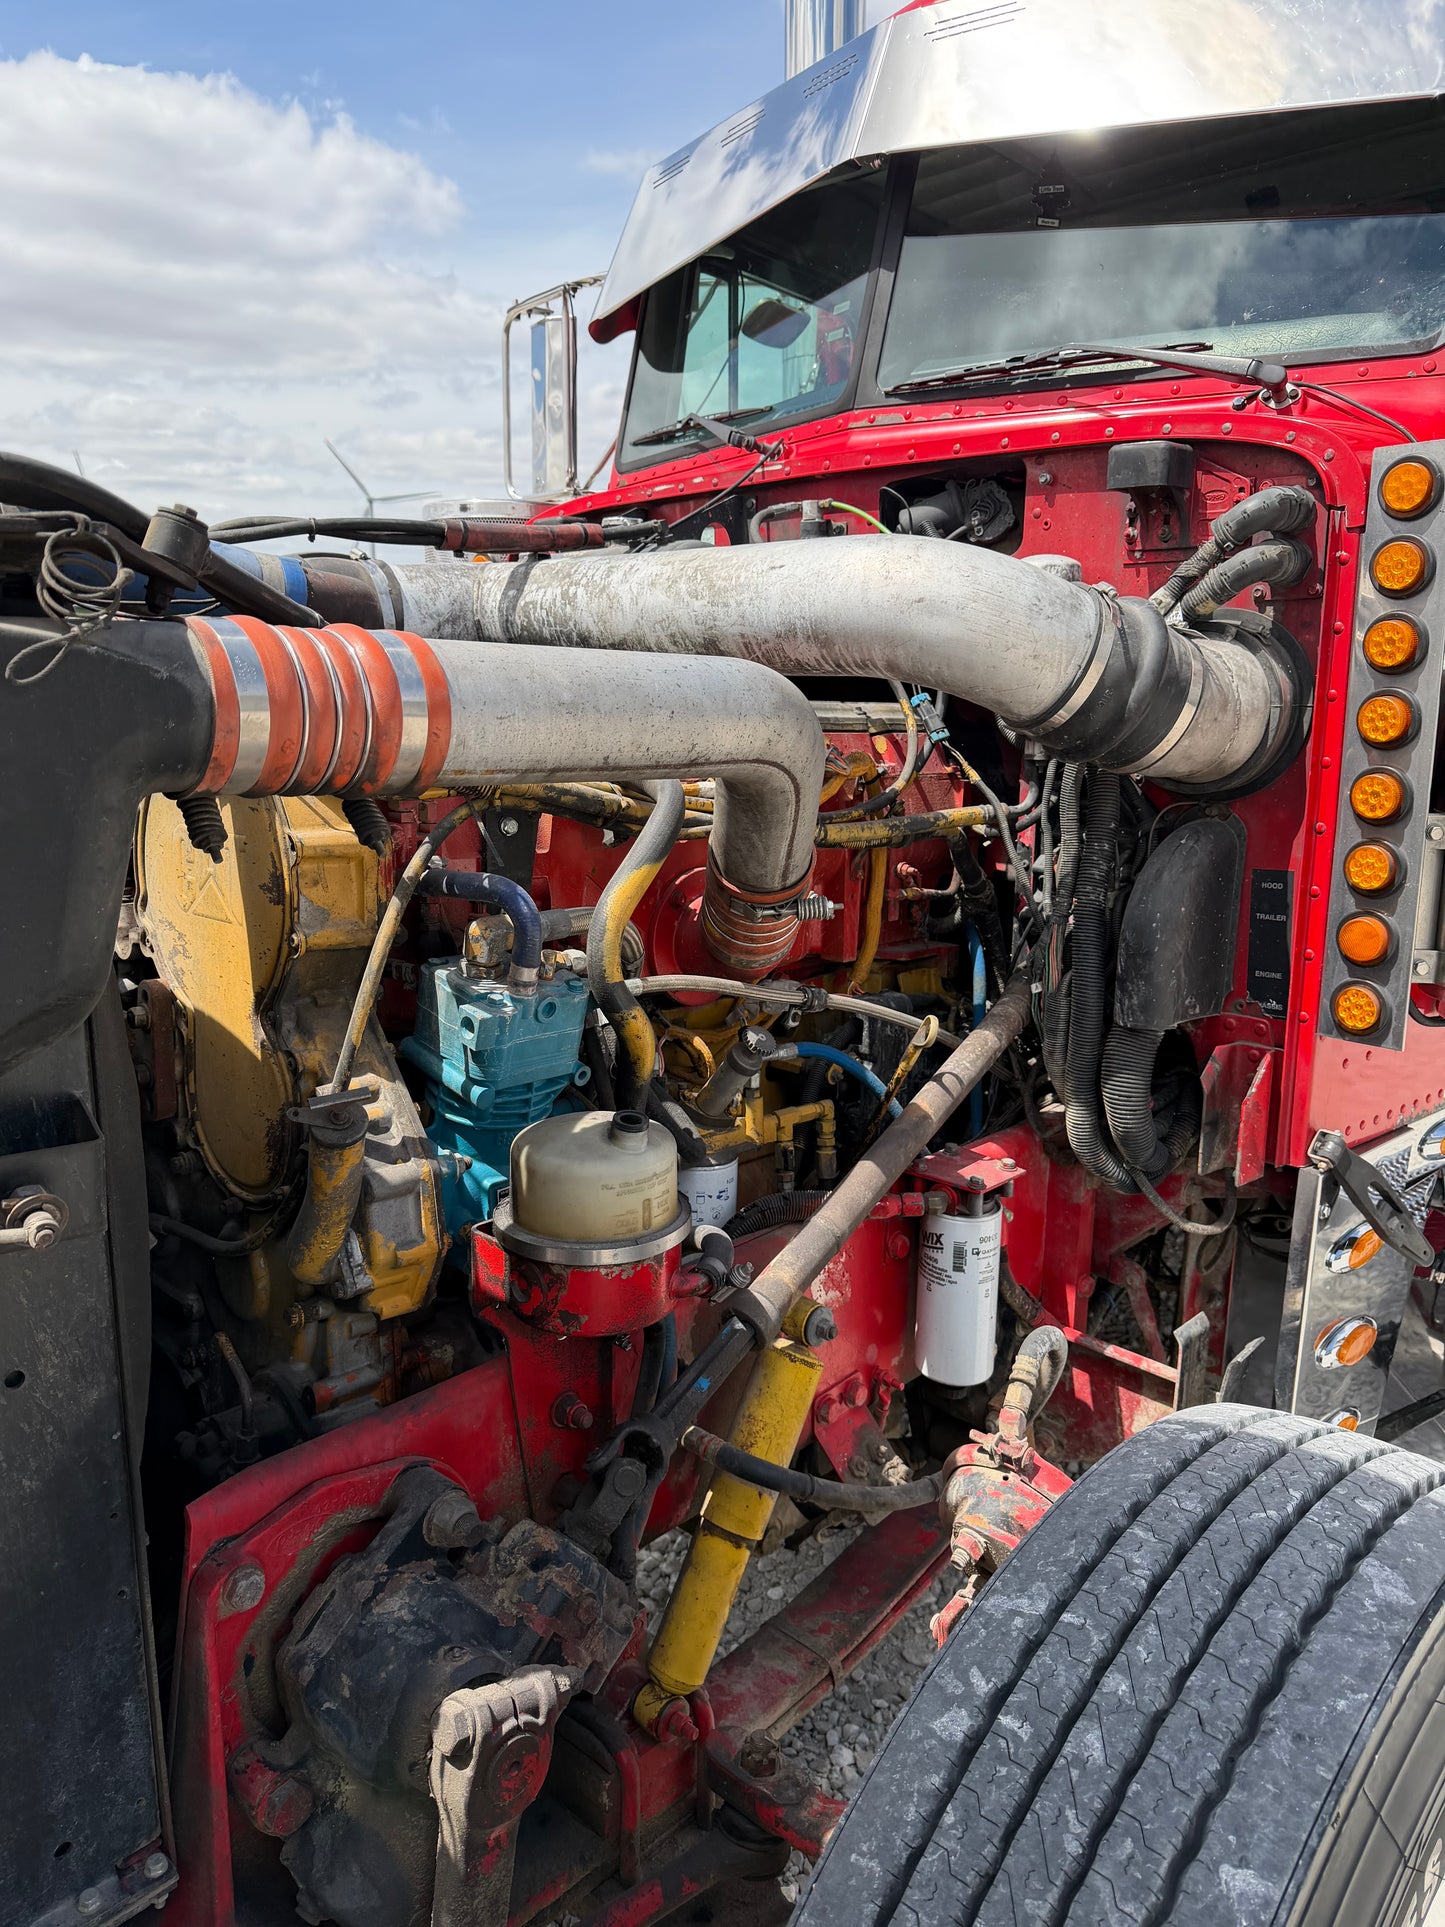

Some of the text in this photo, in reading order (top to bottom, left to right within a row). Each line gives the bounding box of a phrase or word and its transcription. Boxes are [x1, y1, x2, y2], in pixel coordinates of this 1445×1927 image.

[1261, 882, 1284, 890] HOOD
[1255, 912, 1287, 922] TRAILER
[1254, 970, 1283, 980] ENGINE
[922, 1230, 944, 1246] WIX
